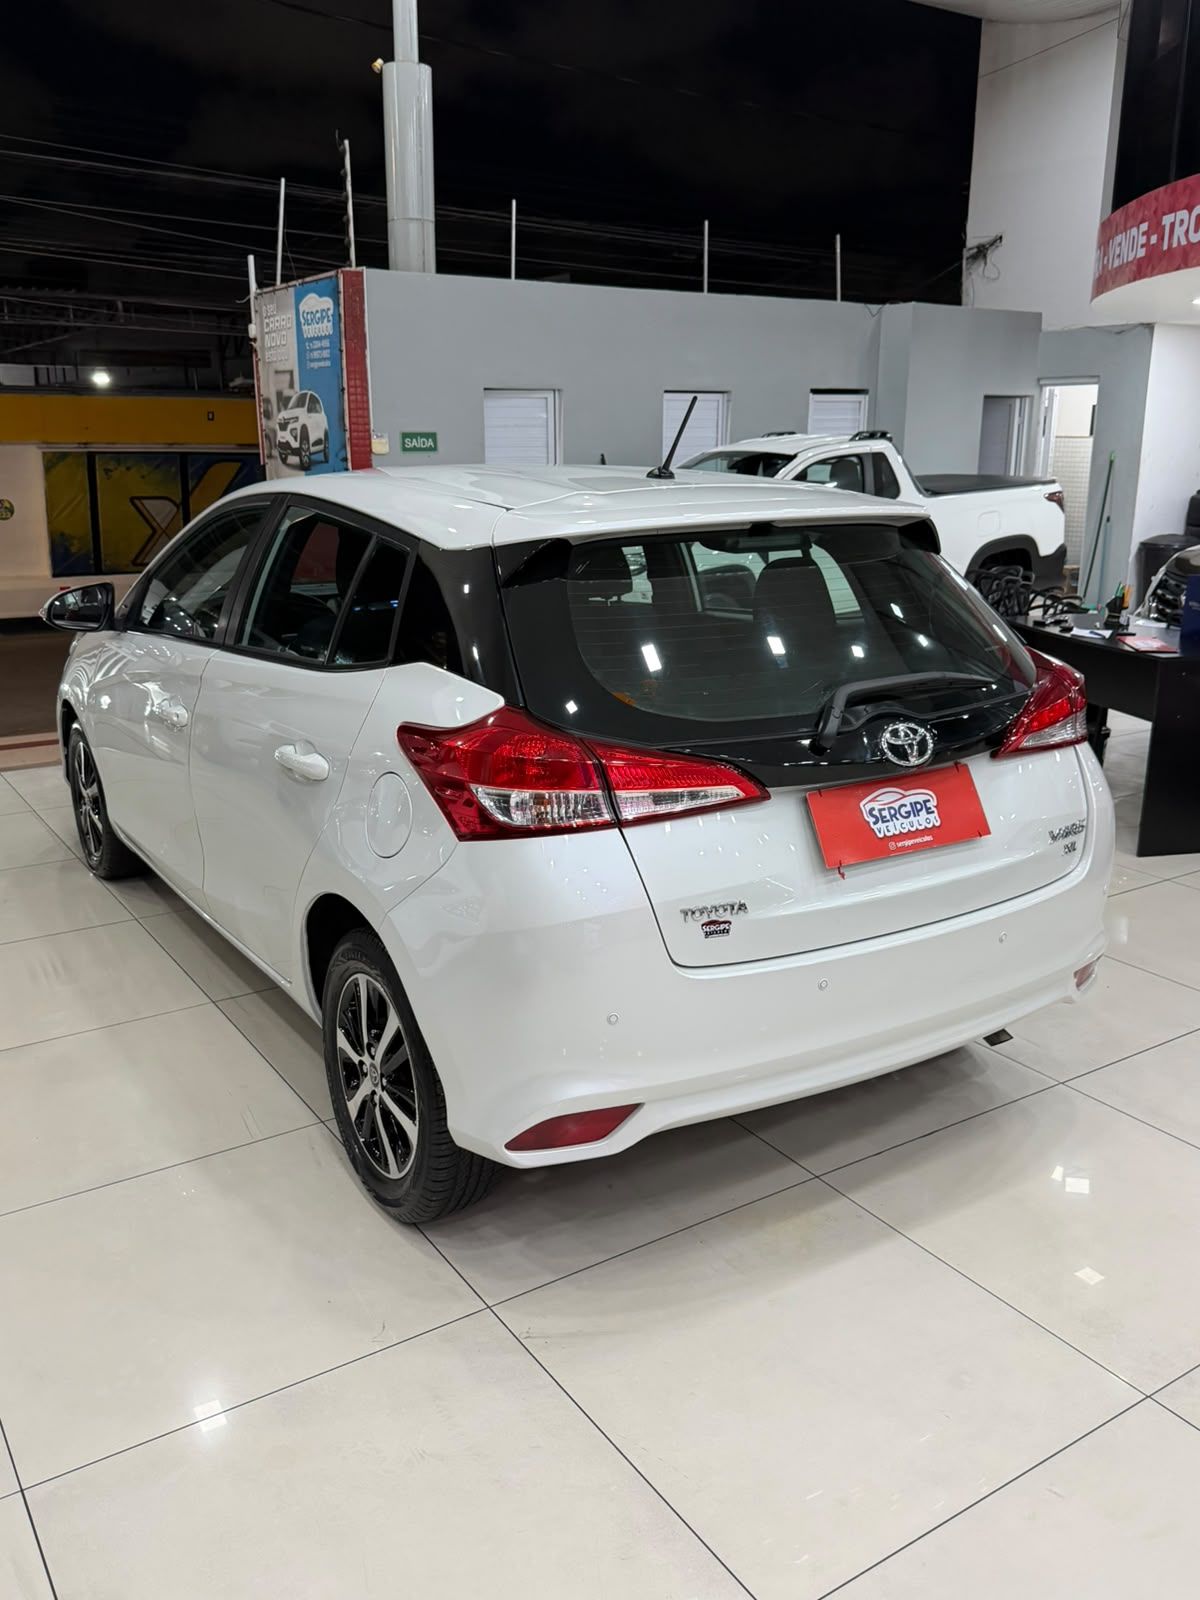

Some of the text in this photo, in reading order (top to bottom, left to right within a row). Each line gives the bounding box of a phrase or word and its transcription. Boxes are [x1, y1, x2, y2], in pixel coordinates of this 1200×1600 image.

[1108, 221, 1149, 271] VENDE
[264, 314, 292, 332] CARRO
[302, 307, 332, 326] SERGIPE
[264, 331, 287, 347] NOVO
[404, 436, 435, 448] SAÍDA
[868, 799, 935, 826] SERGIPE
[680, 900, 748, 923] TOYOTA
